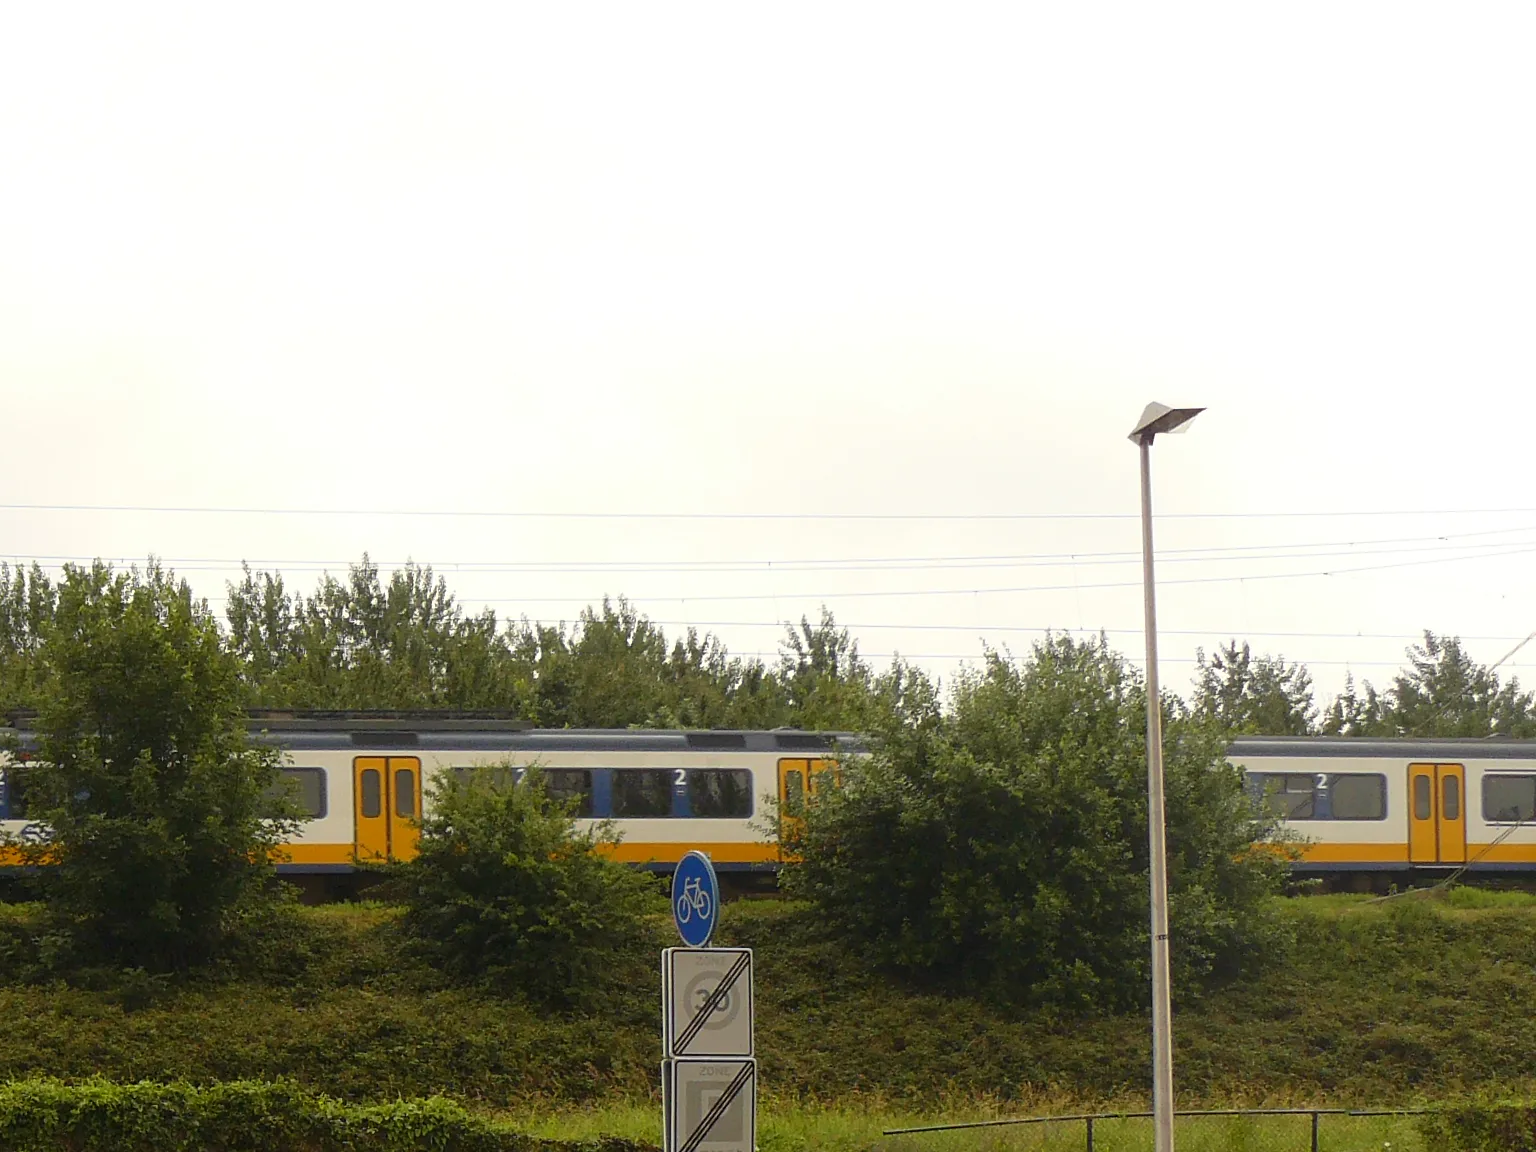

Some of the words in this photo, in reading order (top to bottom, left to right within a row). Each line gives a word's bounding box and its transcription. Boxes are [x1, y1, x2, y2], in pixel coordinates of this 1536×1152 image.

[674, 769, 687, 785] 2
[1316, 773, 1328, 789] 2
[695, 988, 730, 1012] 30
[699, 1066, 731, 1076] ZONE
